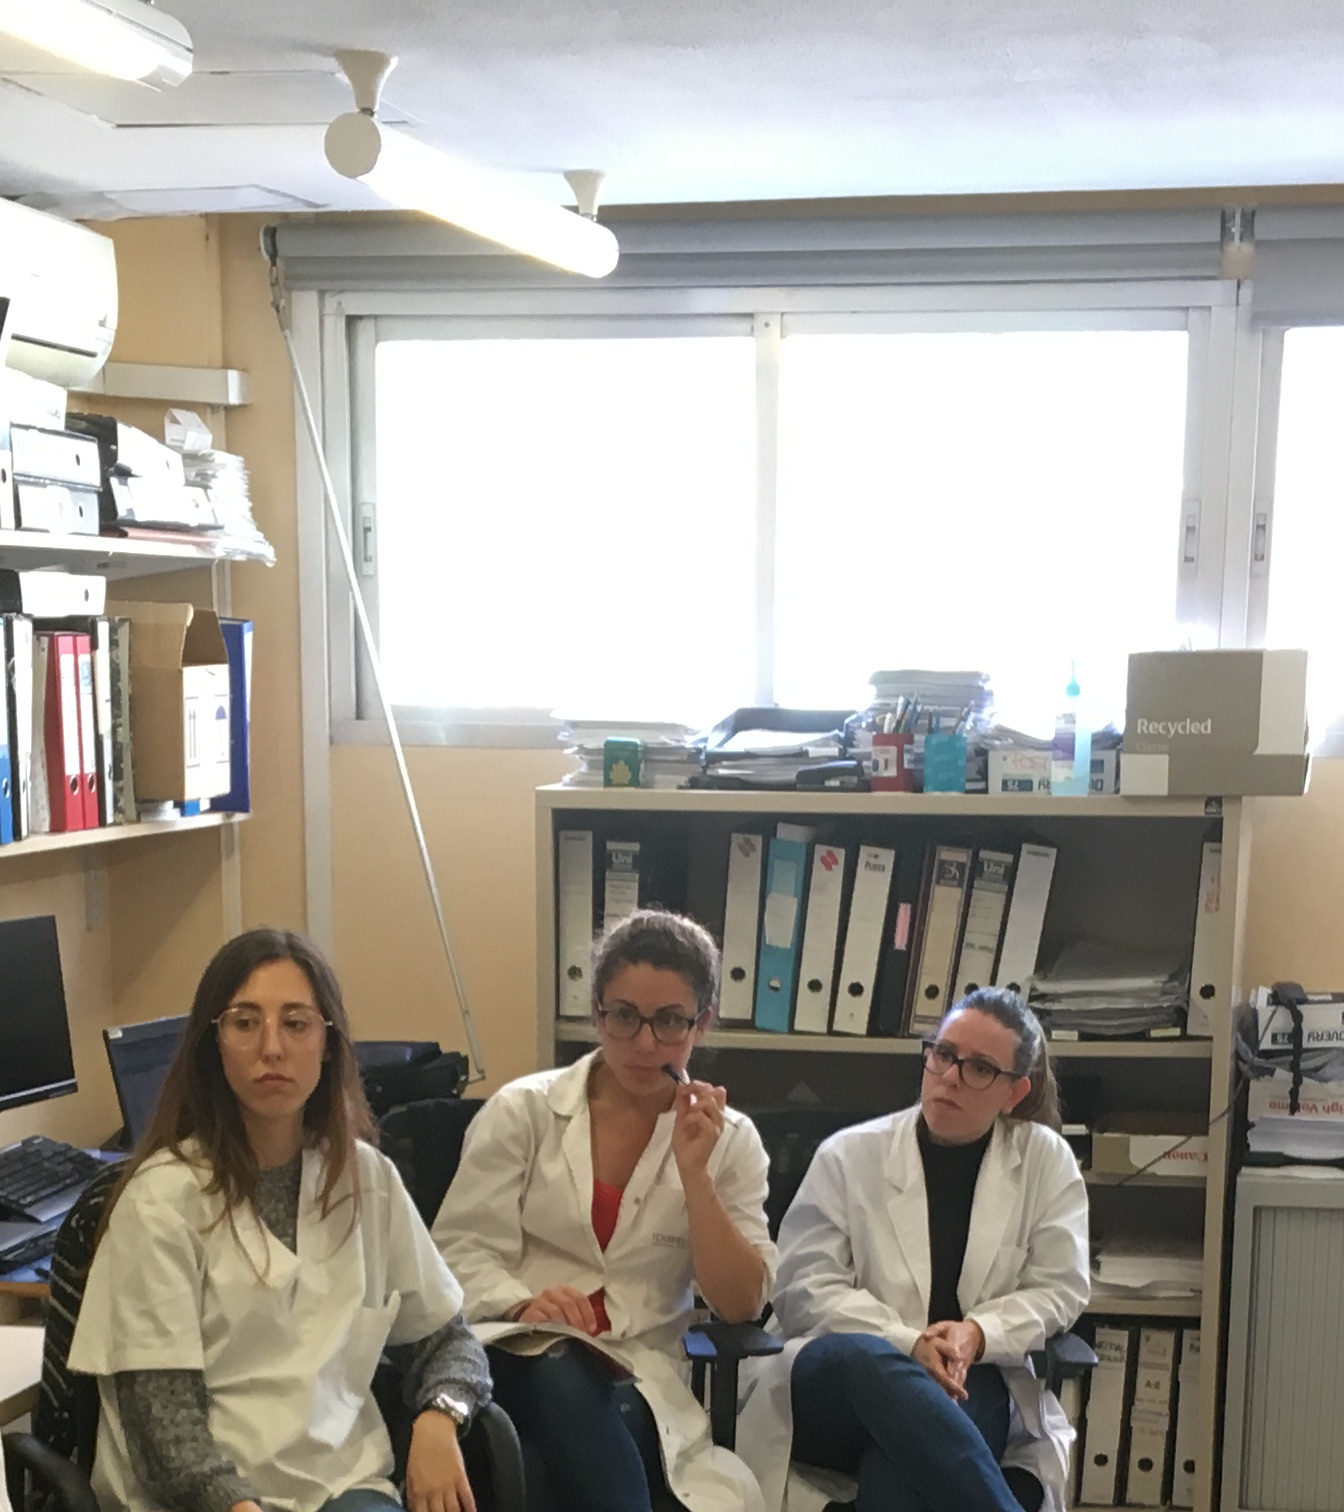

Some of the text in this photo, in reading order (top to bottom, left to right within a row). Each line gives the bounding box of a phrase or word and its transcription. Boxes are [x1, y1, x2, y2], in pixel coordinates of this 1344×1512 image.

[1137, 717, 1212, 738] Recycled
[611, 852, 633, 865] Uni
[983, 859, 1005, 875] Uni
[1269, 1101, 1319, 1114] Volme
